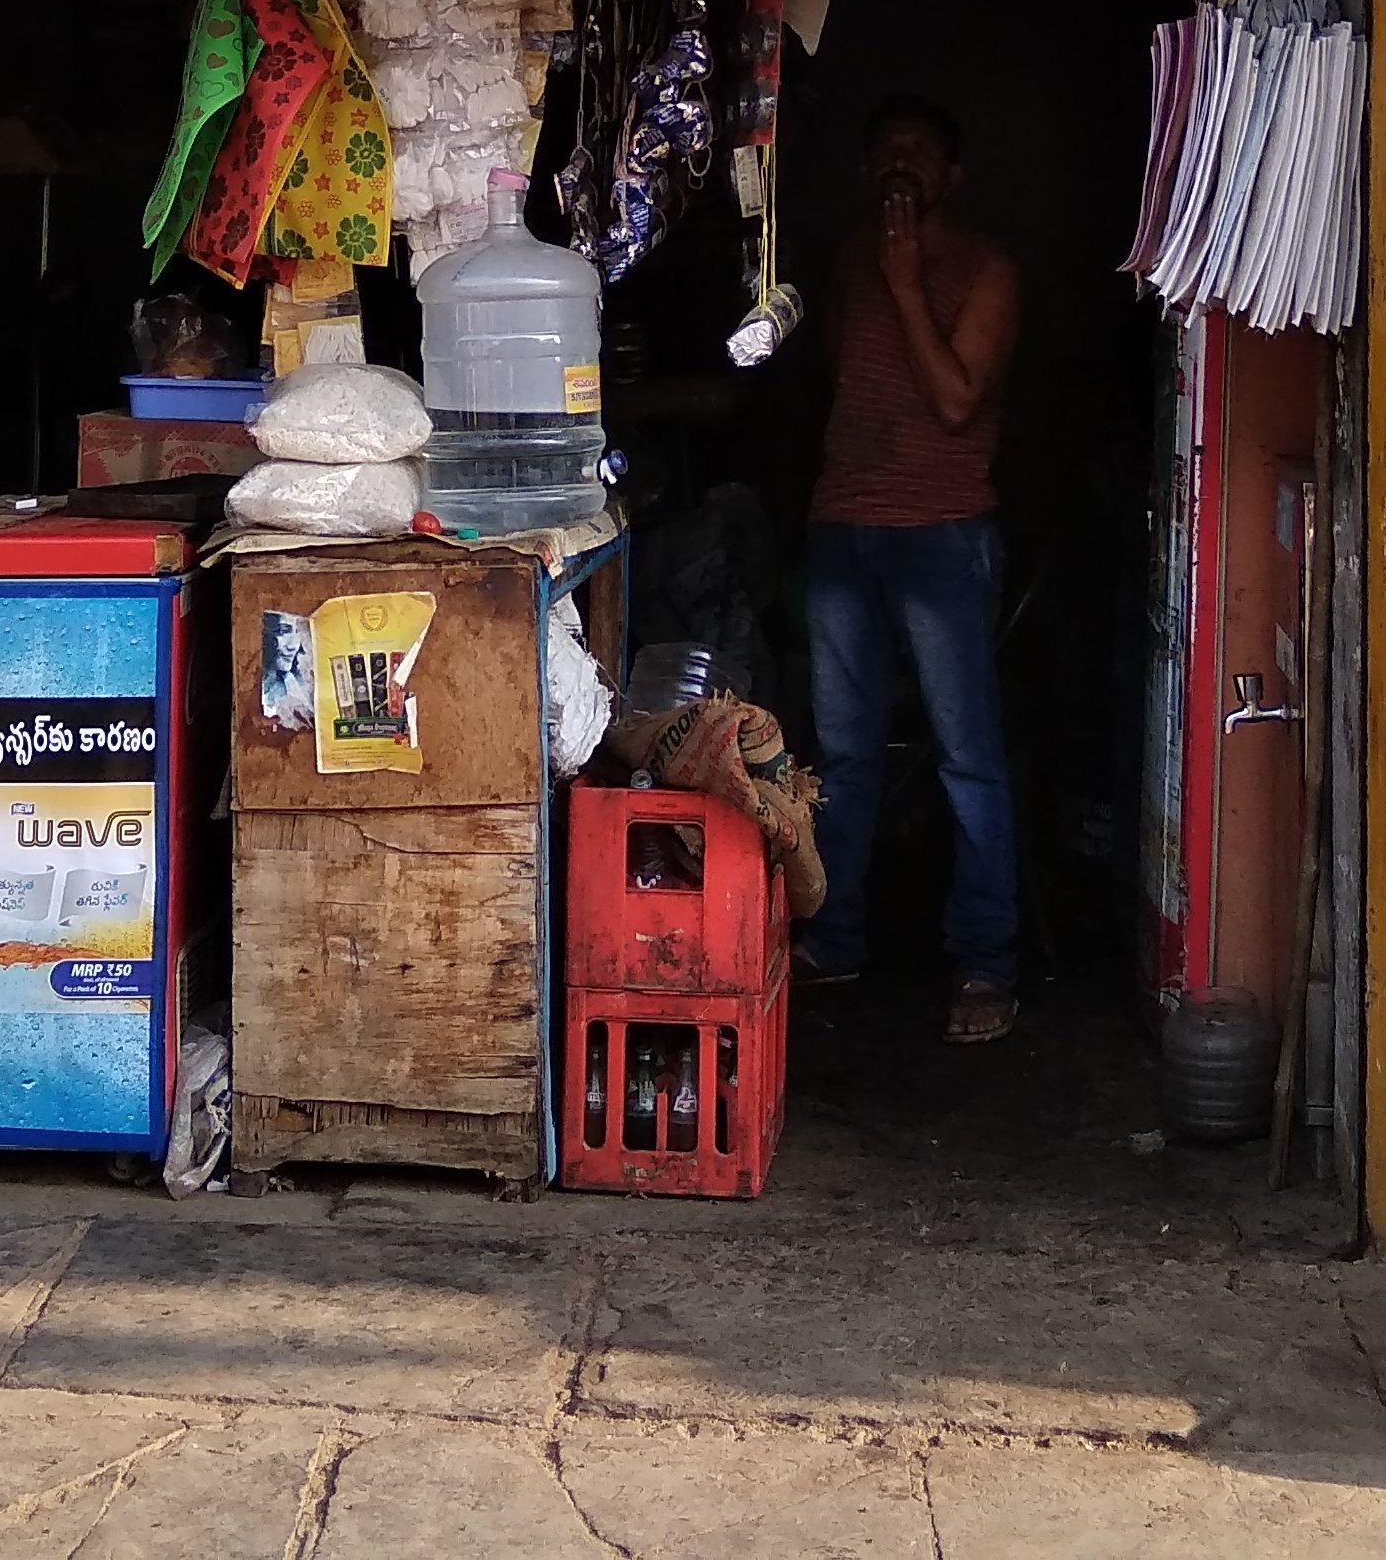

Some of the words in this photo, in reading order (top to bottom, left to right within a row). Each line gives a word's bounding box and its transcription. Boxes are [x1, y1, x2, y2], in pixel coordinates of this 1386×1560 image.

[79, 722, 156, 752] కారణం
[11, 803, 35, 816] NEW
[17, 810, 153, 848] wave
[70, 963, 104, 977] MRP
[106, 963, 133, 977] ₹50
[97, 982, 112, 995] 10
